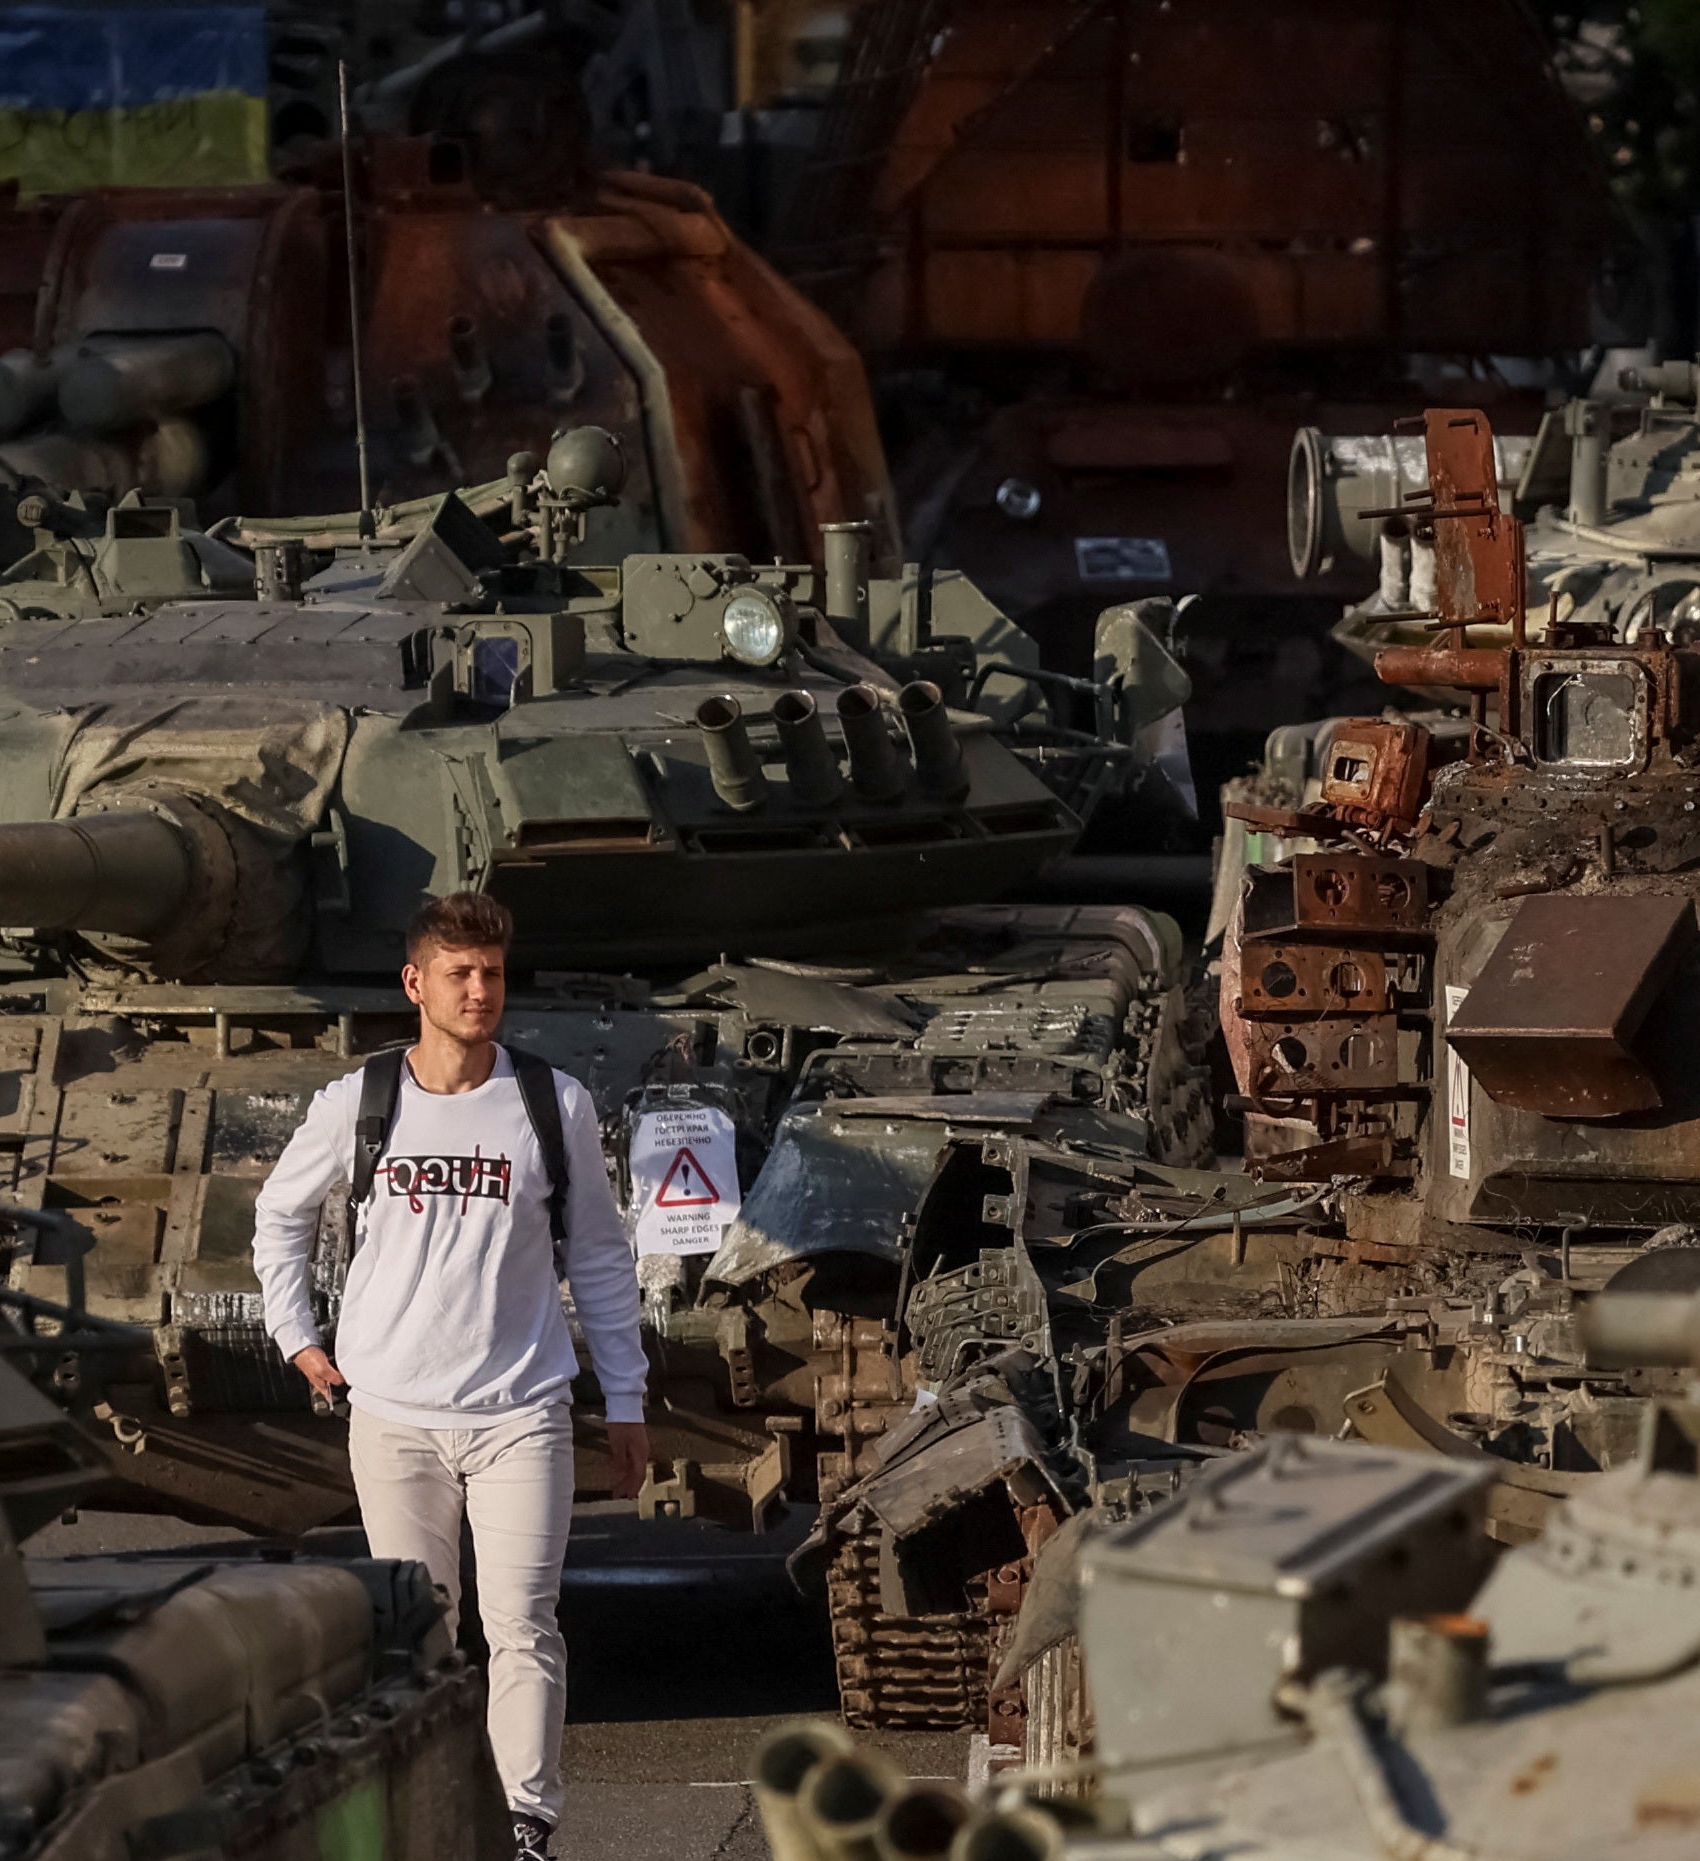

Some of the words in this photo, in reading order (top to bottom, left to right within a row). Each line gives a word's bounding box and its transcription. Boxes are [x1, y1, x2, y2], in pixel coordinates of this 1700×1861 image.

[656, 1113, 706, 1122] ОБЕРЕЖНО
[654, 1136, 711, 1147] НЕБЕЗПЕЧНО
[666, 1212, 710, 1222] WARNING
[660, 1226, 689, 1235] SHARP
[691, 1224, 720, 1234] EDGES
[672, 1236, 709, 1246] DANGER
